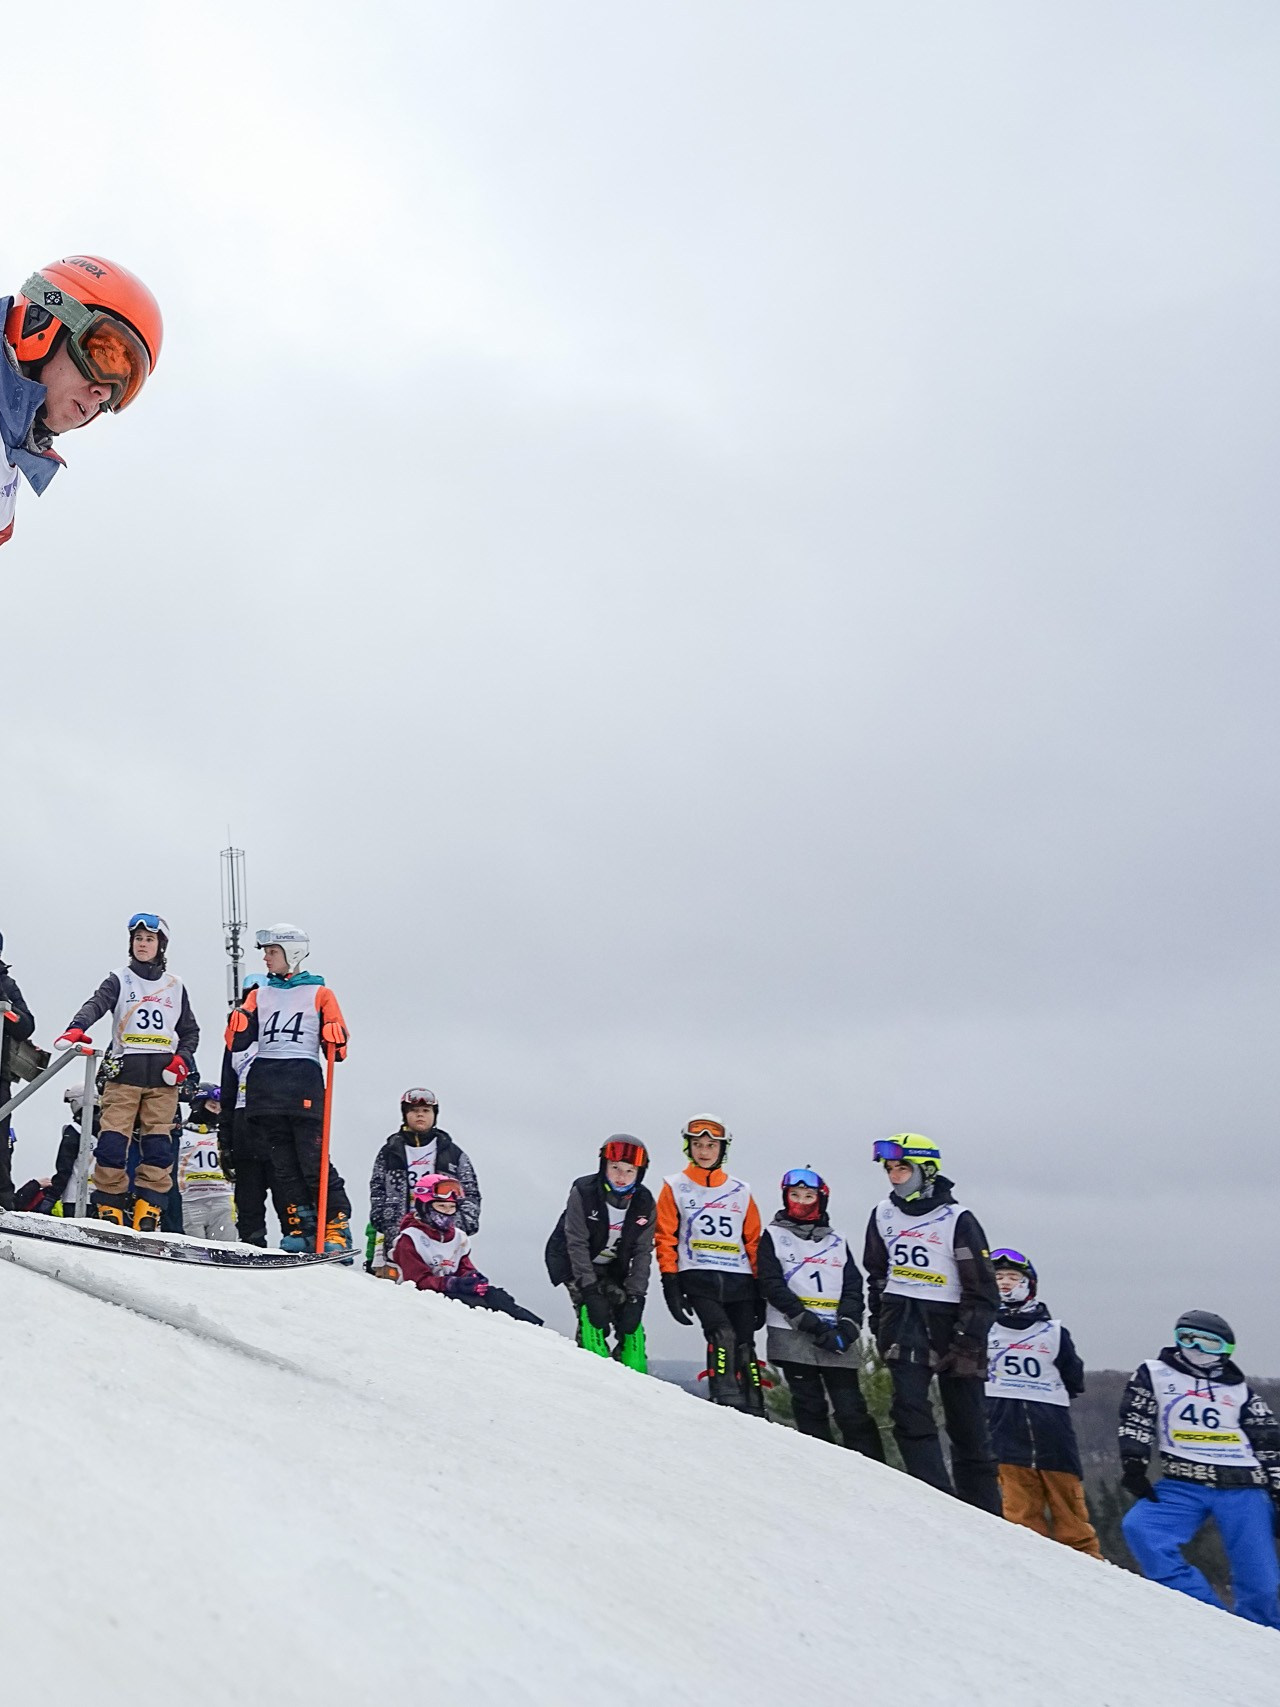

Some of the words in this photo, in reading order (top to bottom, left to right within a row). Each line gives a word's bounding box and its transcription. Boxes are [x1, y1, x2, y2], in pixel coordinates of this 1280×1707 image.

[70, 258, 107, 279] uvex
[136, 1008, 164, 1030] 39
[263, 1010, 305, 1044] 44
[125, 1036, 168, 1045] FISCHER
[194, 1151, 218, 1168] 10
[699, 1214, 732, 1237] 35
[692, 1243, 736, 1252] FISCHER
[894, 1244, 929, 1268] 56
[809, 1270, 823, 1293] 1
[1004, 1355, 1041, 1378] 50
[1179, 1403, 1221, 1429] 46
[1174, 1432, 1230, 1442] FISCHER
